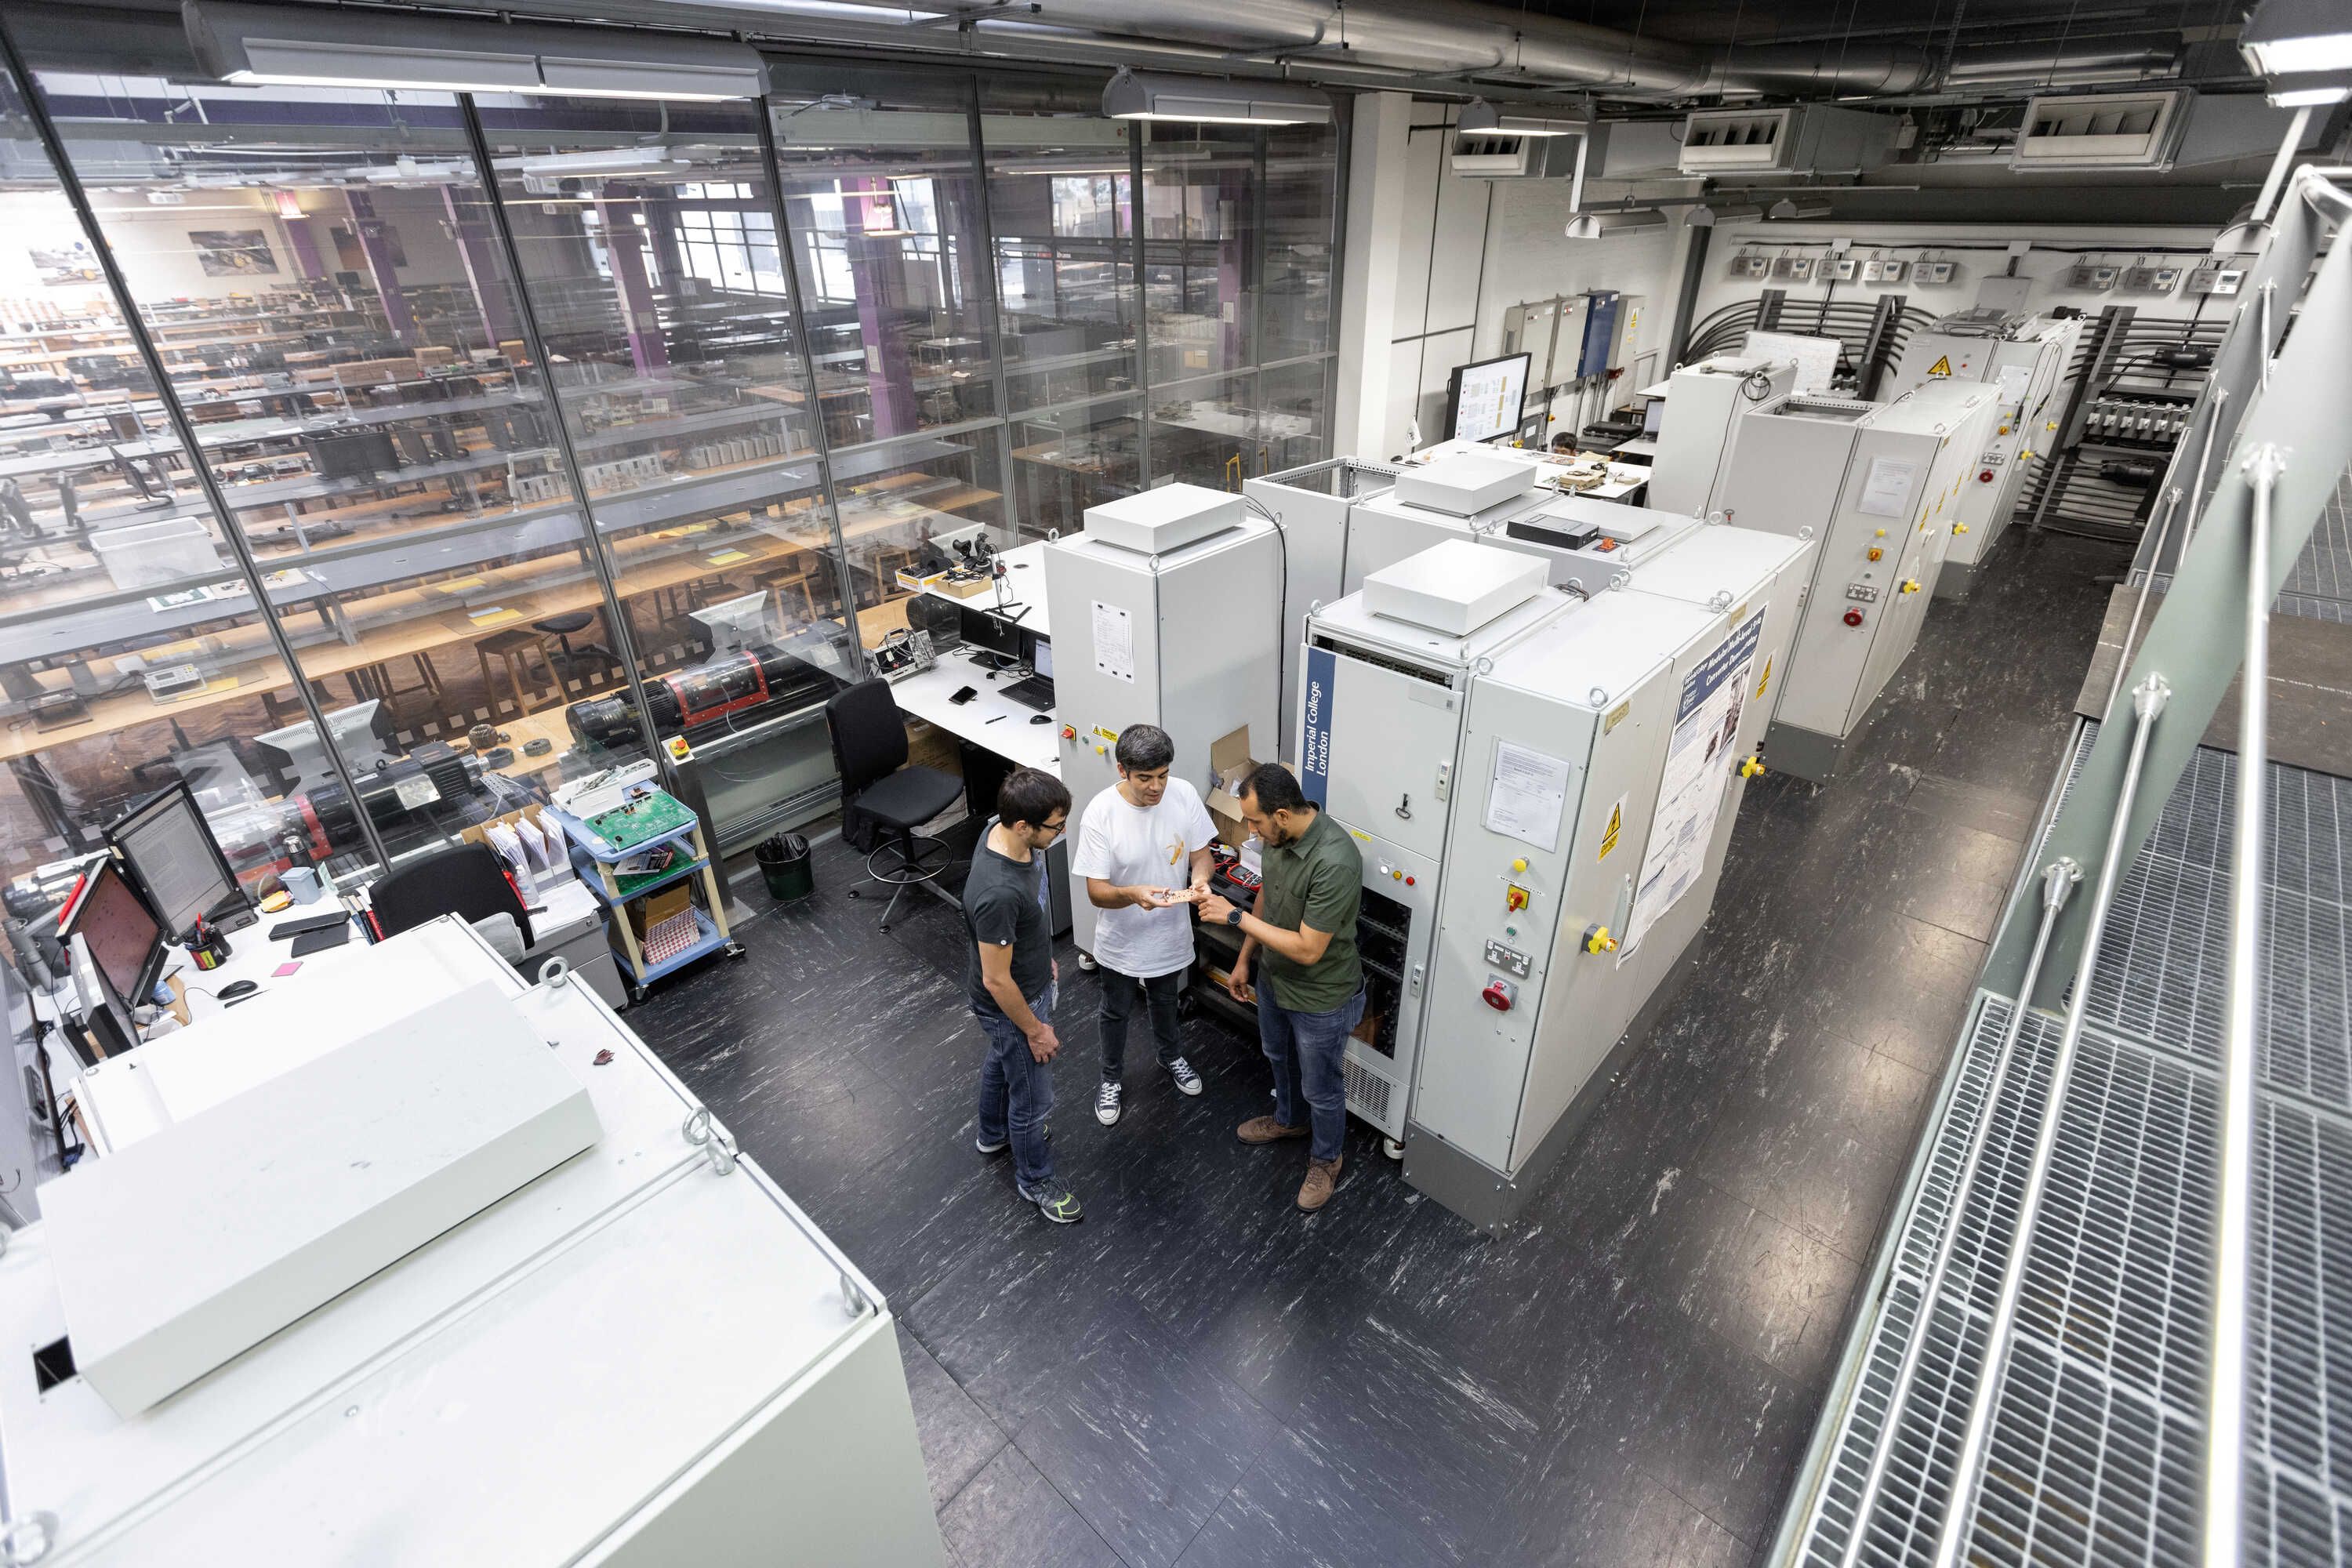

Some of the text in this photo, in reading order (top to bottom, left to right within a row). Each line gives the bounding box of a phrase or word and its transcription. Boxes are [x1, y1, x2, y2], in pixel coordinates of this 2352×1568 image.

[1305, 681, 1322, 771] Imperial College
[1316, 731, 1329, 776] London
